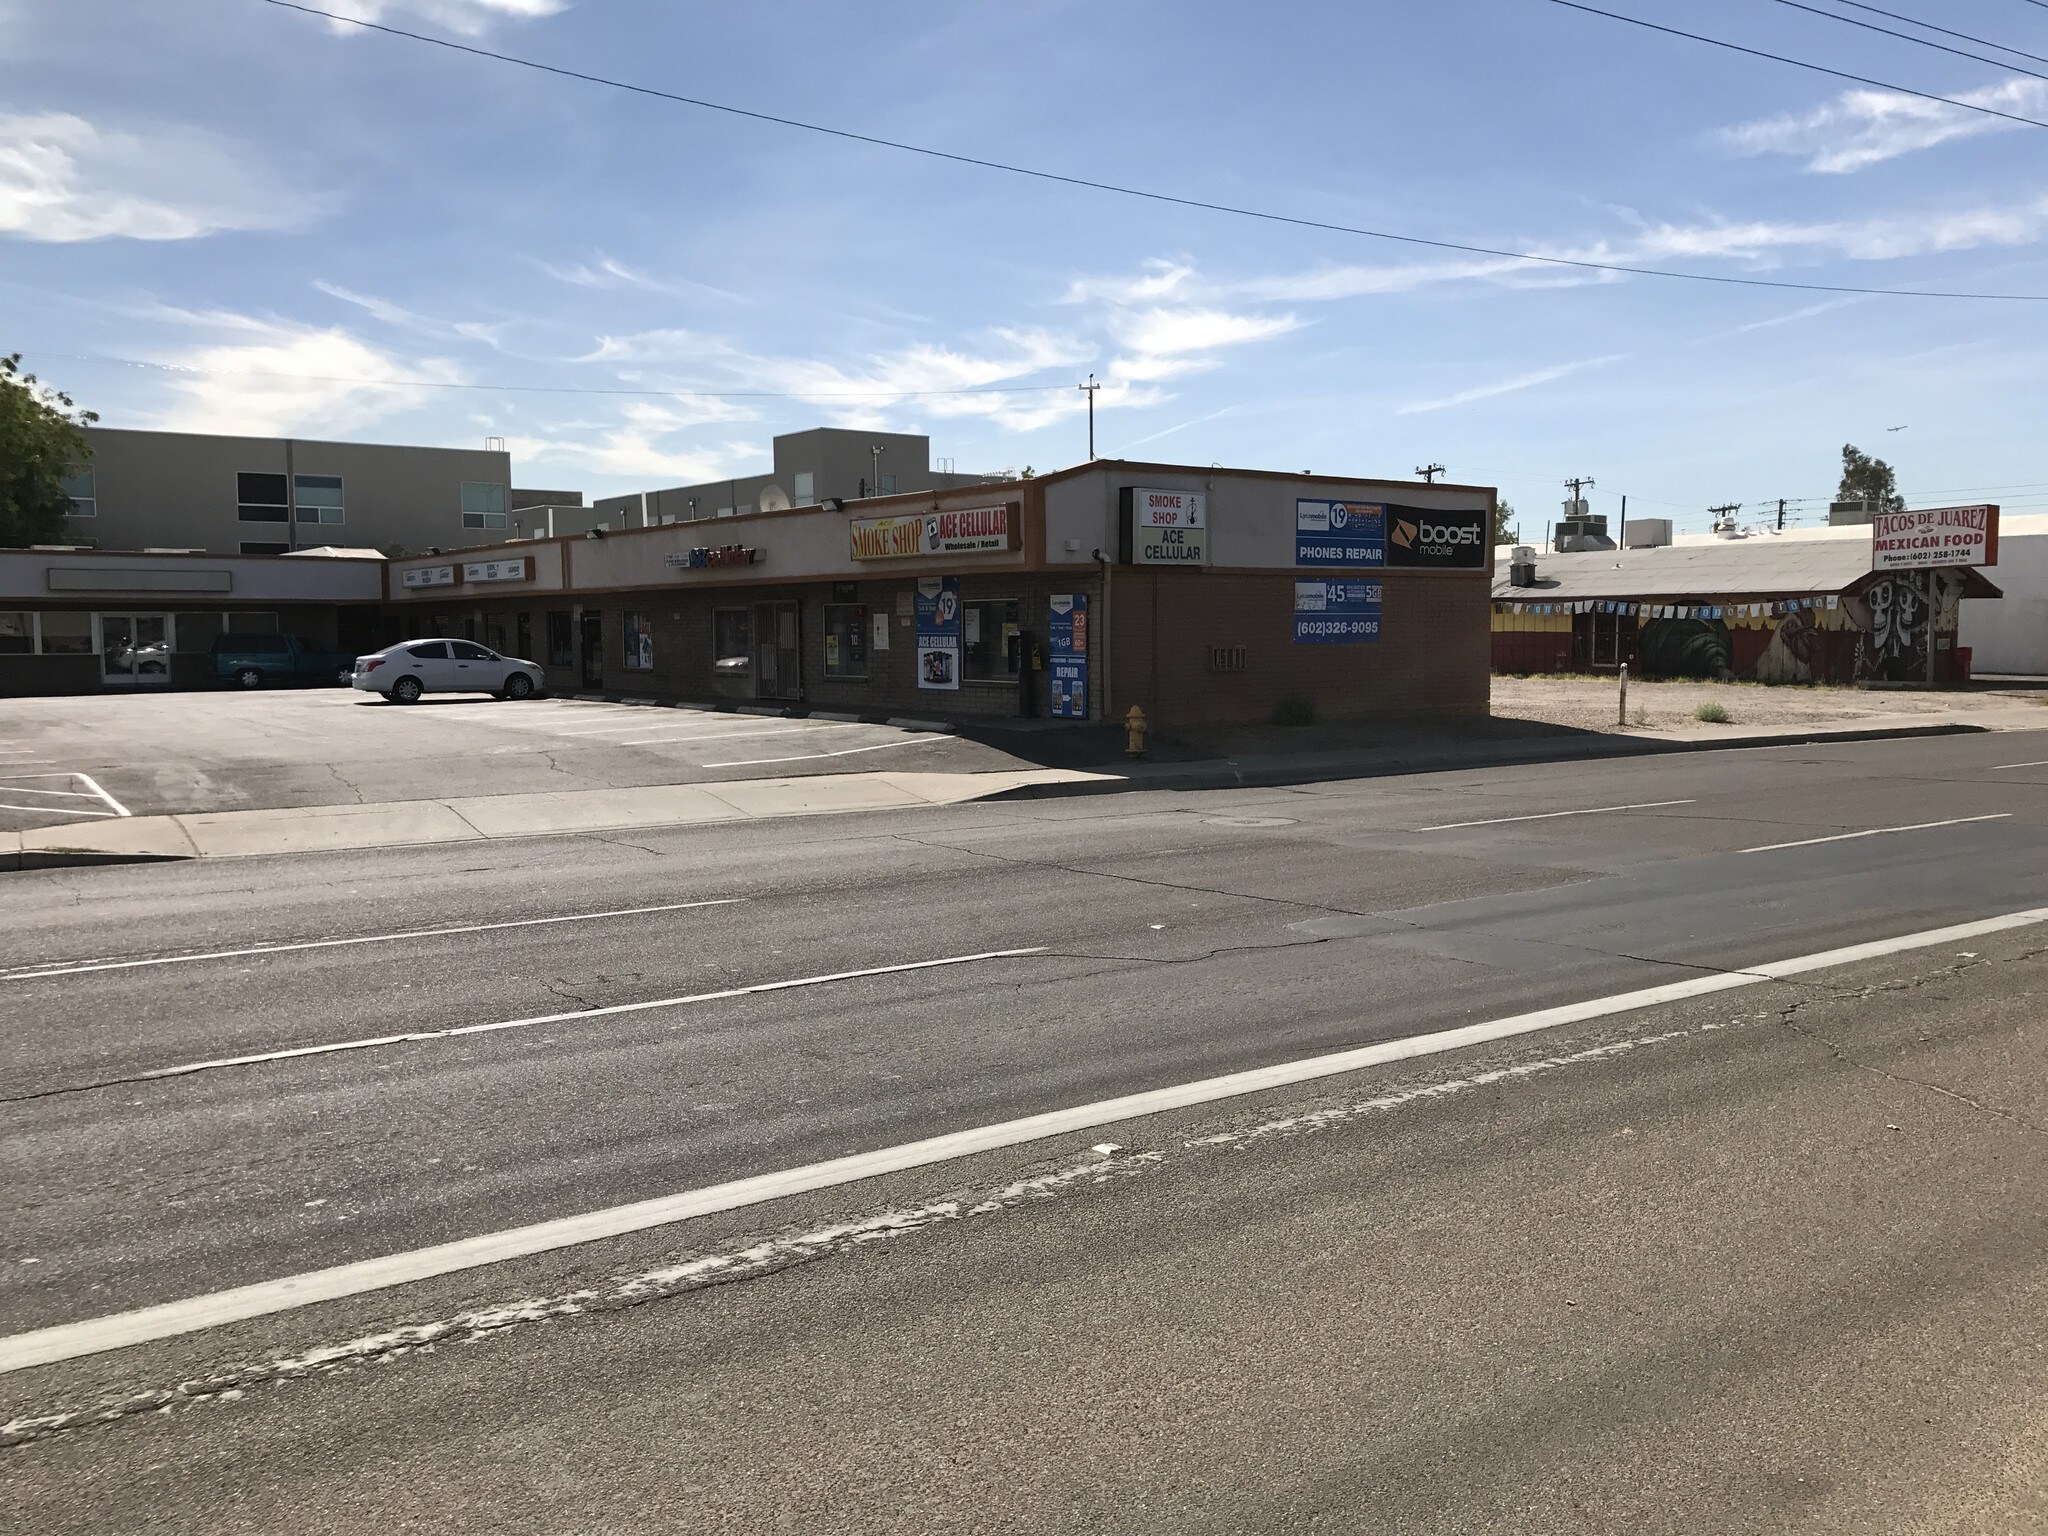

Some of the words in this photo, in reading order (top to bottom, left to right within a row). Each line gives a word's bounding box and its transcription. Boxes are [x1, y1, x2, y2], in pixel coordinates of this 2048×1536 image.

[1149, 495, 1181, 508] SMOKE
[1153, 512, 1178, 524] SHOP
[1333, 508, 1346, 524] 19
[940, 514, 958, 539] ACE
[960, 510, 1007, 537] CELLULAR
[1876, 515, 1915, 539] TACOS
[1918, 513, 1934, 525] DE
[1938, 509, 1986, 531] JUAREZ
[852, 524, 890, 558] SMOKE
[892, 518, 922, 555] SHOP
[1162, 530, 1184, 544] ACE
[1420, 519, 1481, 545] boost
[945, 541, 976, 551] Wholesale
[981, 539, 1000, 549] Retail
[1875, 536, 1940, 551] MEXICAN
[1944, 533, 1983, 546] FOOD
[1145, 545, 1201, 560] CELLULAR
[1300, 546, 1344, 559] PHONES
[1346, 547, 1383, 560] REPAIR
[1420, 544, 1454, 556] mobile
[1933, 549, 1971, 559] 258-1744
[942, 598, 954, 614] 19
[1075, 614, 1085, 626] 23
[1298, 621, 1379, 637] (602)326-9095
[918, 636, 929, 648] ACE
[930, 636, 957, 648] CELLULAR
[1056, 666, 1079, 678] REPAIR
